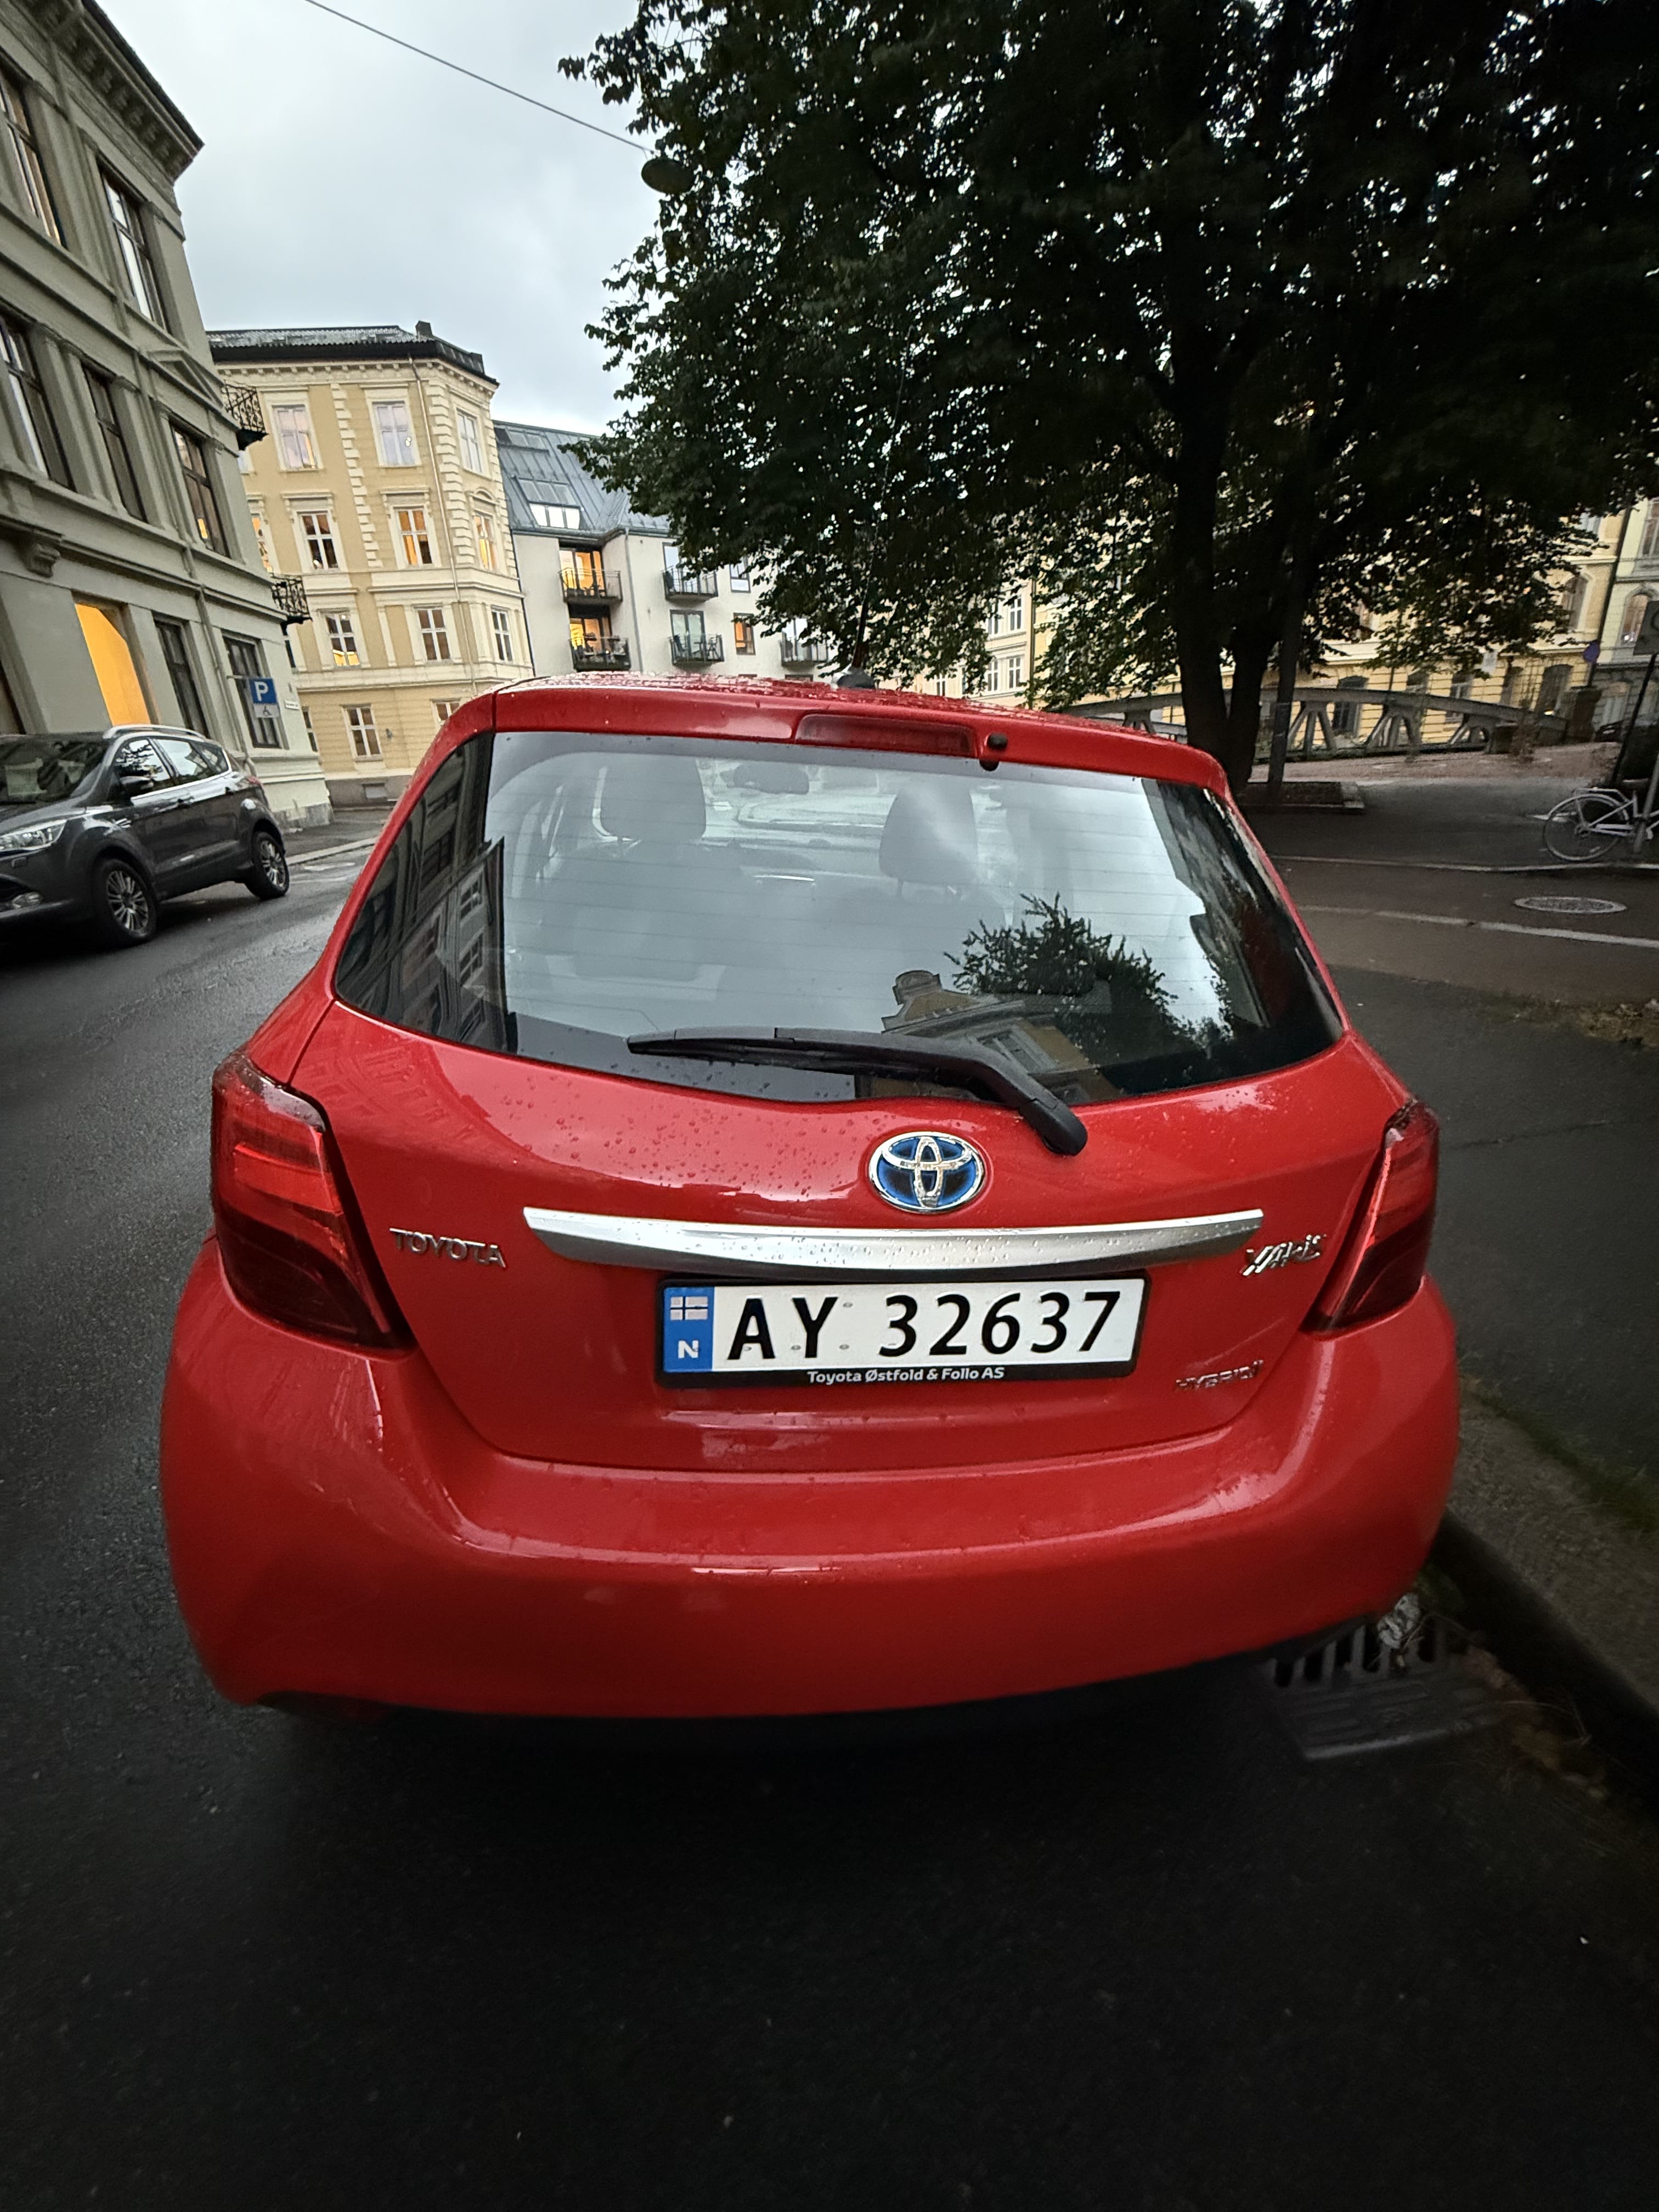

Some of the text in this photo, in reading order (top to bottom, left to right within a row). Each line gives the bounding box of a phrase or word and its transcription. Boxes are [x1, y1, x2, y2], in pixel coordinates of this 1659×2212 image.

[253, 681, 269, 702] P
[389, 1227, 506, 1268] TOYOTA
[726, 1291, 1121, 1360] AY 32637
[678, 1340, 699, 1359] N
[807, 1367, 1005, 1385] Toyota Østfold & Follo AS
